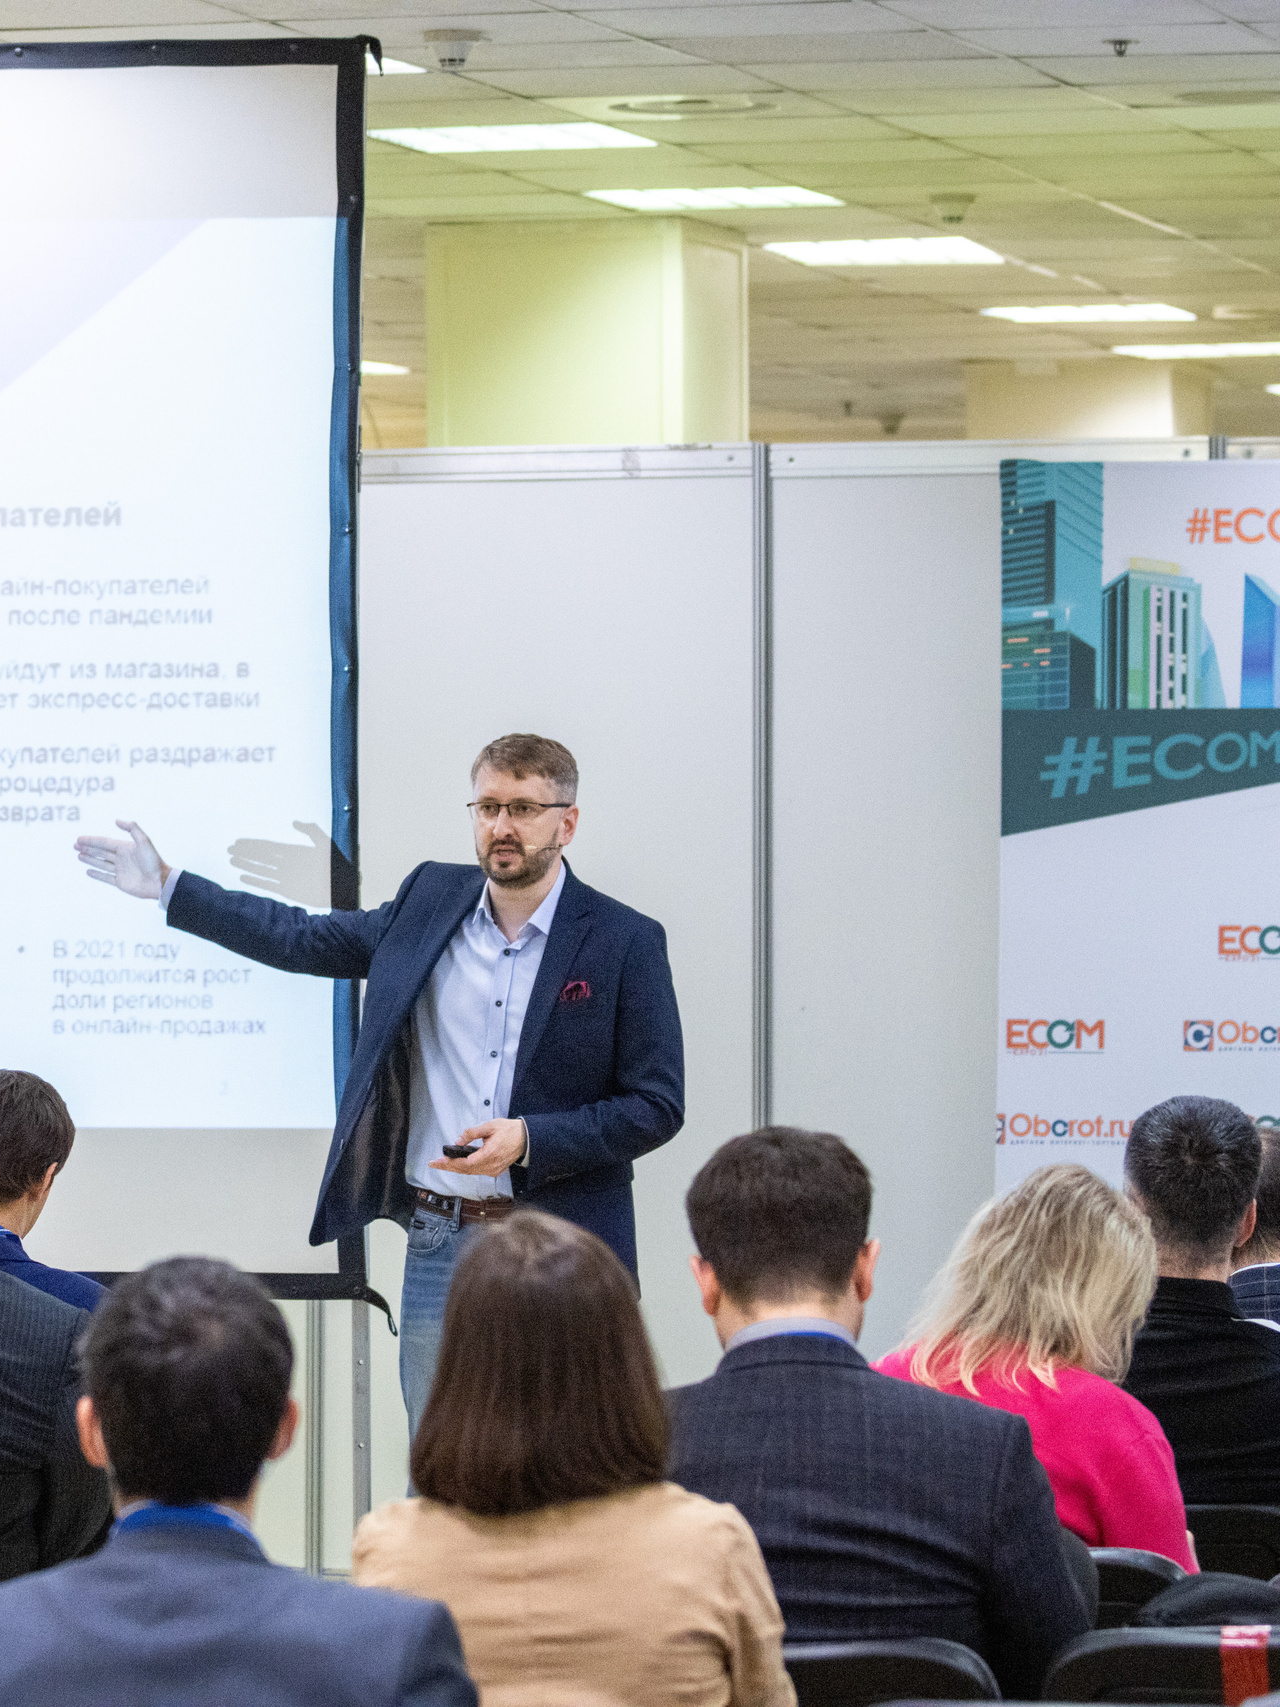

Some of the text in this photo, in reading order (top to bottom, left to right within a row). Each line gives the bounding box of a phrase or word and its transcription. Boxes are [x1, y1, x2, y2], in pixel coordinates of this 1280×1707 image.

[8, 608, 80, 627] после
[90, 607, 213, 628] пандемии
[70, 661, 96, 680] из
[105, 659, 226, 682] магазина,
[236, 661, 250, 678] в
[28, 689, 260, 712] экспресс-доставки
[130, 746, 276, 768] раздражает
[54, 940, 180, 962] В 2021 году
[53, 968, 252, 988] продолжится рост
[52, 994, 212, 1013] доли регионов
[53, 1018, 266, 1037] в онлайн-продажах
[1006, 1020, 1104, 1049] ECOM
